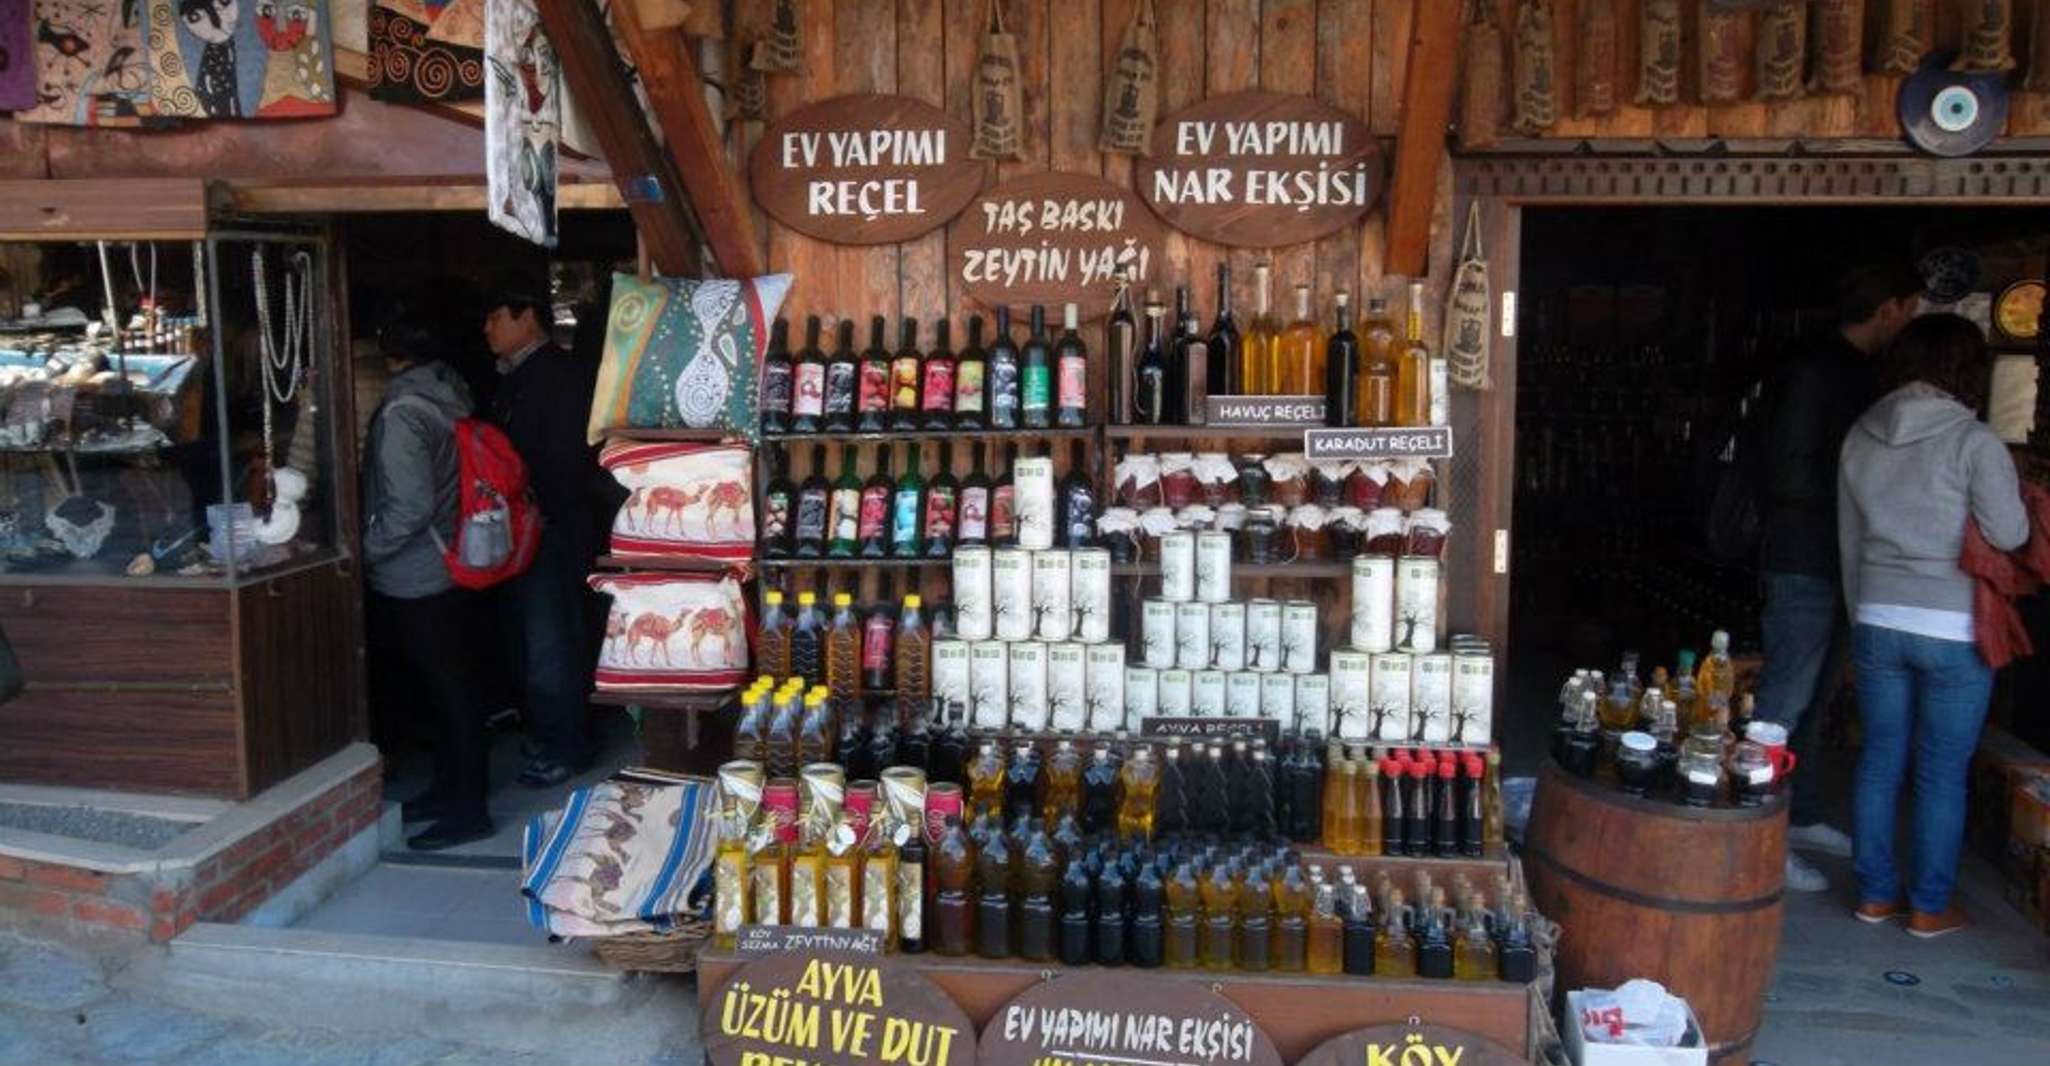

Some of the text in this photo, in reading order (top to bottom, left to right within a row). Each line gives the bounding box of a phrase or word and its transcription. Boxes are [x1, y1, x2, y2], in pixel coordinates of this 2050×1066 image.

[782, 129, 945, 168] EV YAPIMI
[1176, 121, 1344, 156] EV YAPIMI
[808, 180, 925, 221] REÇEL
[1154, 162, 1367, 210] NAR EKŞİSİ
[983, 199, 1124, 237] TAŞ BASKI
[962, 236, 1150, 287] ZEYTİN YAĞI
[1220, 404, 1272, 421] HAVUÇ
[1315, 433, 1443, 452] KARADUT REÇELİ
[1156, 723, 1200, 734] AYVA
[750, 928, 772, 938] KÖY
[796, 958, 883, 1007] AYVA
[721, 981, 959, 1066] ÜZÜM VE DUT
[1004, 1005, 1254, 1062] EV YAPIMI NAR EKŞİSİ
